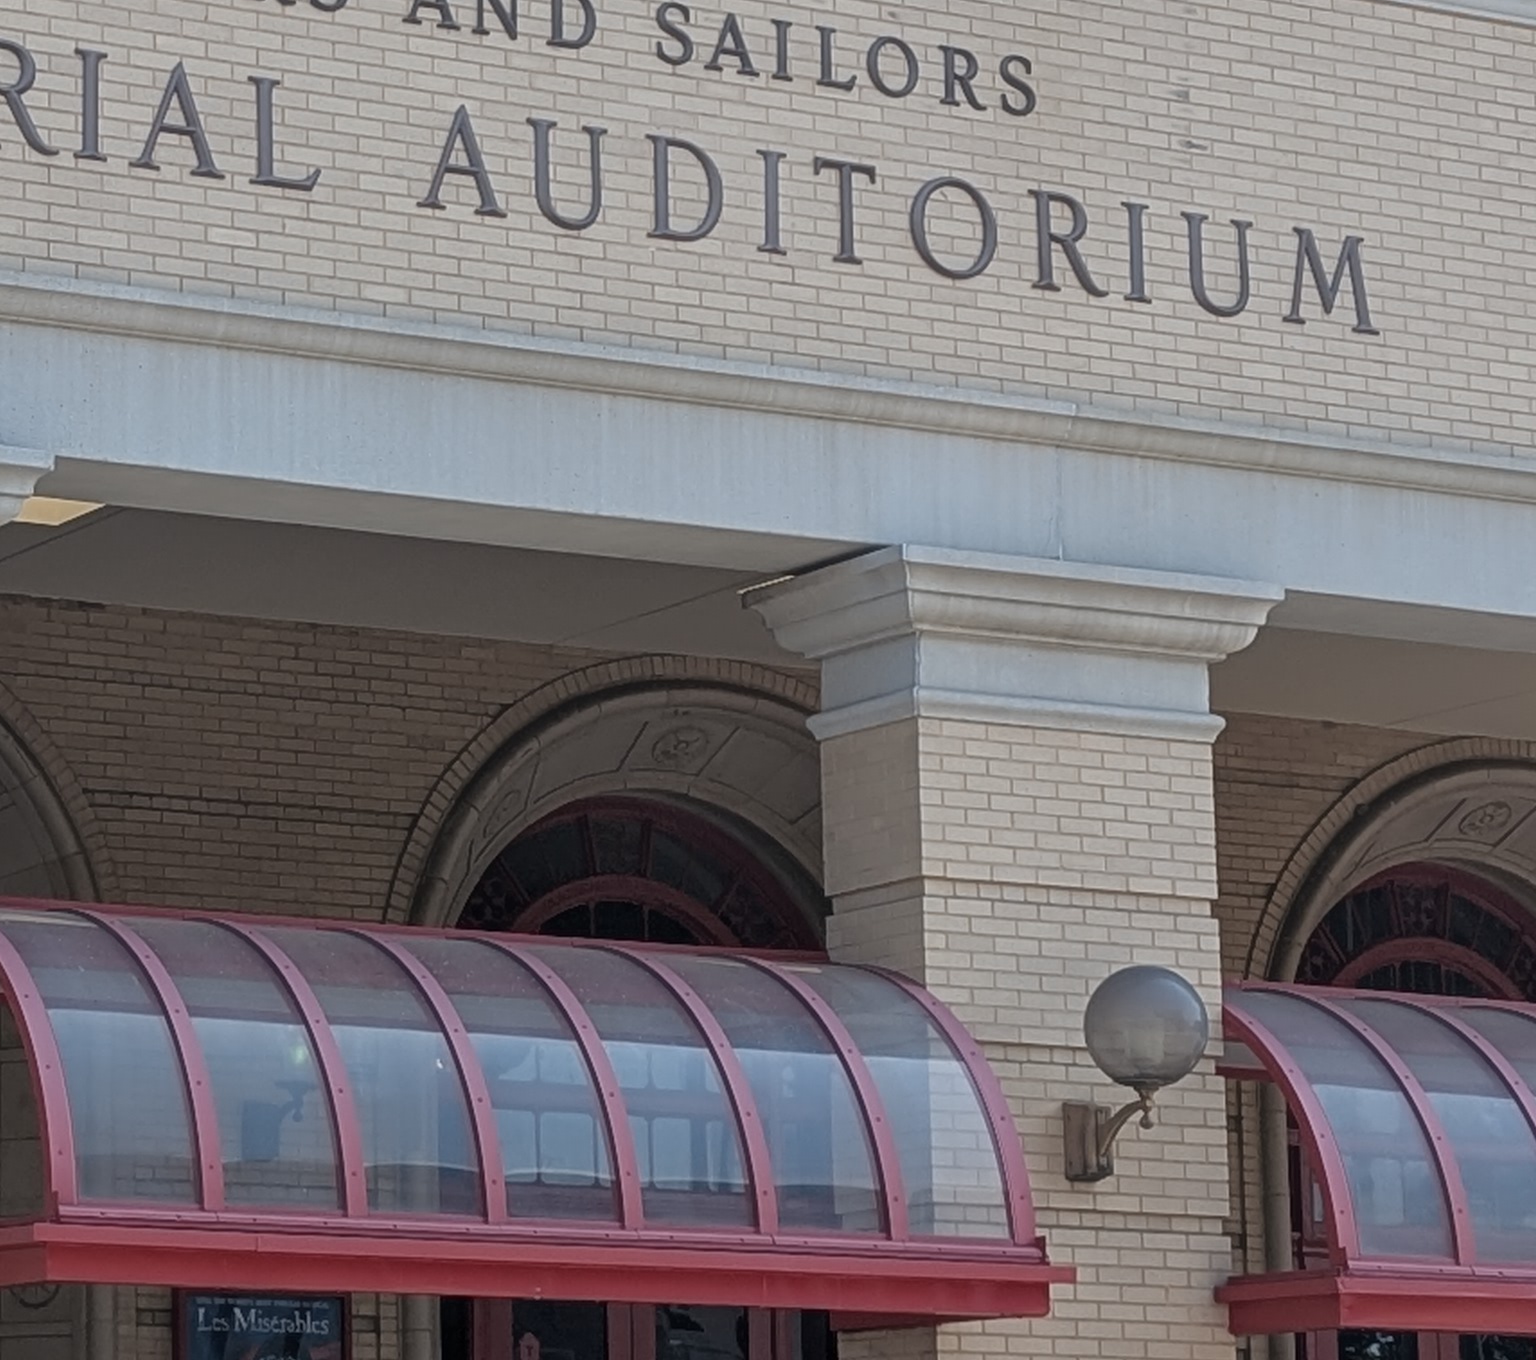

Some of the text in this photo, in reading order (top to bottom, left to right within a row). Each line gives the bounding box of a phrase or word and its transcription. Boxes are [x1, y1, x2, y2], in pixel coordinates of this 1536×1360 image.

[655, 1, 1037, 117] SAILORS
[416, 104, 1380, 336] AUDITORIUM
[197, 1307, 230, 1332] Les
